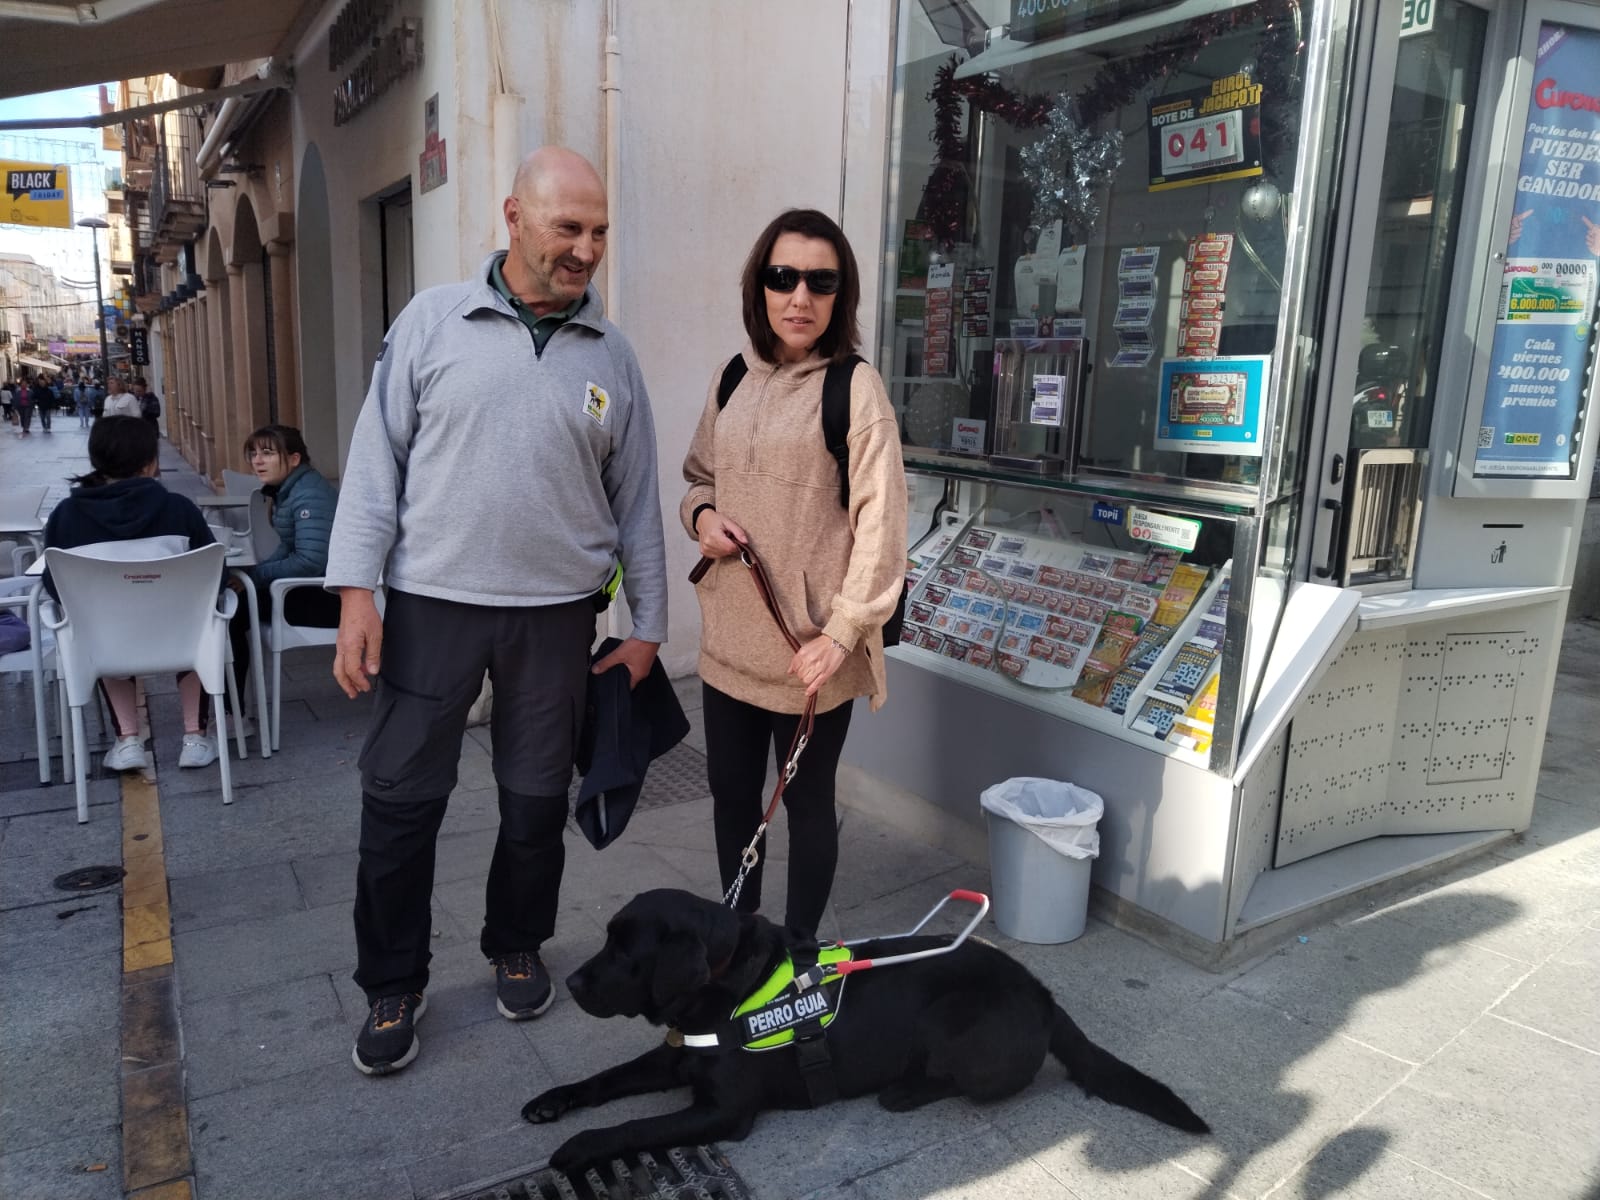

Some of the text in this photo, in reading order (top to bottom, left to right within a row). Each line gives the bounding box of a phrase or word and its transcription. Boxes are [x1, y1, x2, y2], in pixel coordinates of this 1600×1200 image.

[1212, 72, 1244, 96] EURO
[1152, 108, 1195, 127] BOTE DE
[1528, 123, 1548, 134] Por
[1548, 125, 1567, 137] los
[1568, 128, 1588, 139] dos
[1168, 122, 1228, 158] 041
[1545, 160, 1584, 179] SER
[11, 172, 51, 189] BLACK
[1556, 263, 1587, 275] 00000
[134, 331, 145, 362] MANGO
[1525, 339, 1555, 351] Cada
[1512, 351, 1562, 364] viernes
[1498, 365, 1570, 382] 400.000
[1509, 384, 1556, 394] nuevos
[1501, 396, 1558, 408] premios
[1515, 435, 1539, 443] ONCE
[748, 1004, 794, 1034] PERRO
